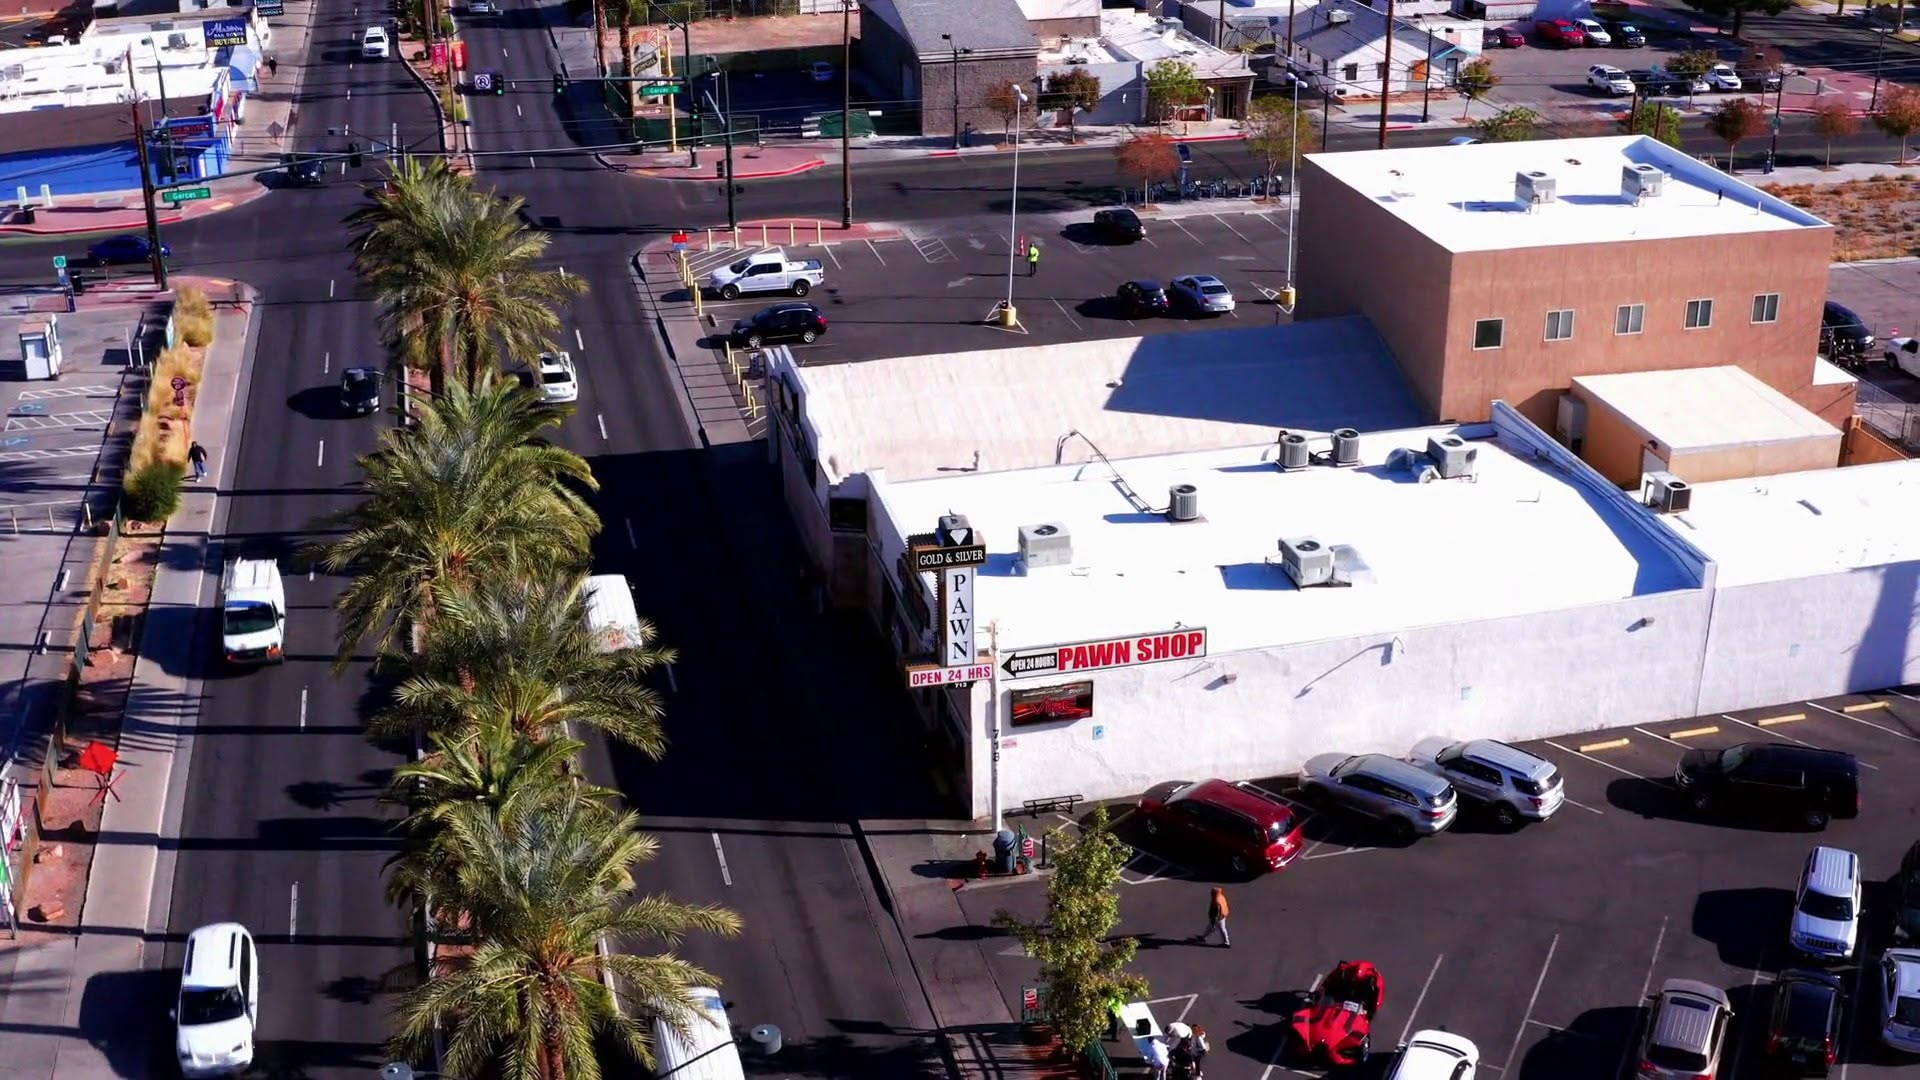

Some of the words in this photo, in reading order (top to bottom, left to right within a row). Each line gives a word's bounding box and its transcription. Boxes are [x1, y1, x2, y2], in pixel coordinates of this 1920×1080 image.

[172, 192, 197, 200] Garces
[920, 553, 943, 566] GOLD
[945, 552, 953, 564] &
[955, 549, 984, 563] SILVER
[949, 573, 971, 660] PAWN
[1057, 640, 1130, 671] PAWN
[1137, 632, 1203, 662] SHOP
[1010, 659, 1026, 671] OPEN
[1026, 657, 1035, 670] 24
[1035, 655, 1055, 669] HOURS
[912, 671, 942, 686] OPEN
[948, 669, 962, 682] 24
[968, 666, 991, 679] HRS
